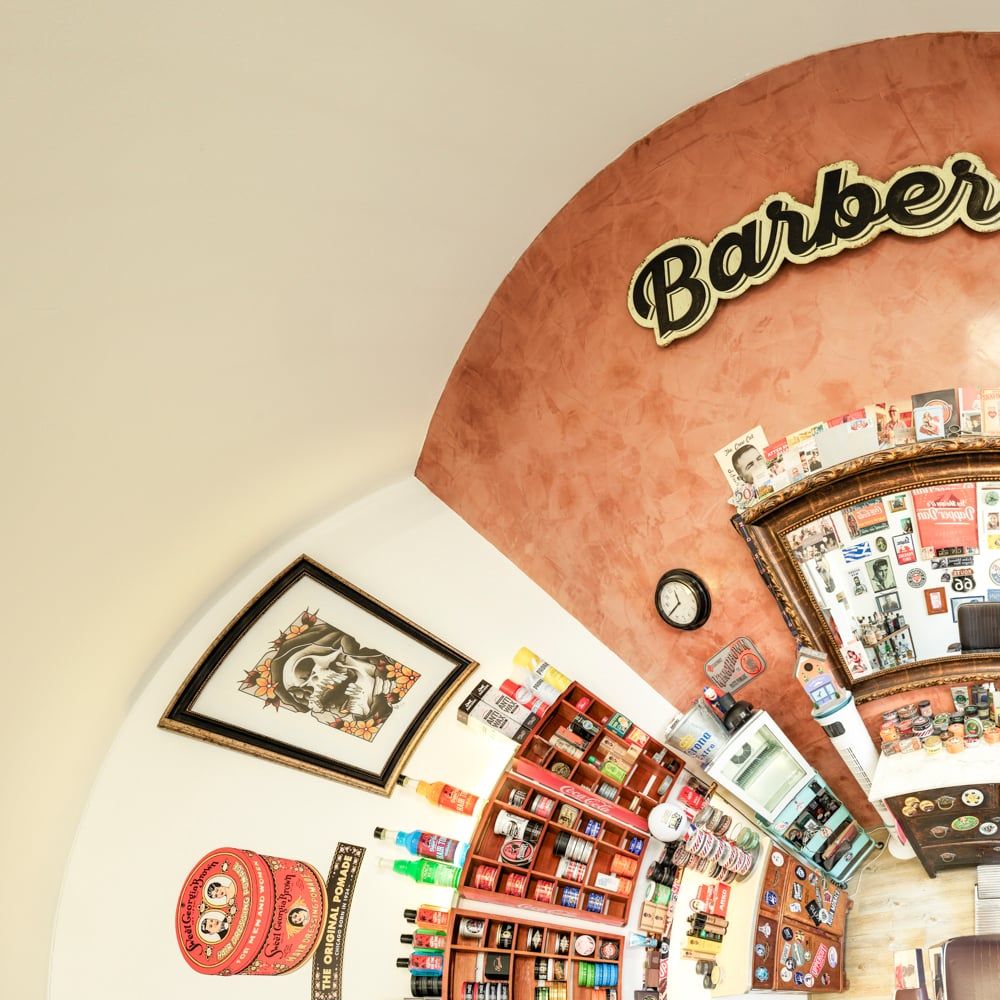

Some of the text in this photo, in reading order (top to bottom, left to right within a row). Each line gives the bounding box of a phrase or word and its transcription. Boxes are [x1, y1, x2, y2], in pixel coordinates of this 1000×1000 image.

[486, 709, 499, 724] ANTI
[498, 695, 511, 709] ANTI
[503, 699, 516, 713] WAX
[491, 713, 505, 728] WAX
[302, 872, 318, 901] POMADE
[718, 889, 727, 911] ARKO
[181, 861, 218, 954] Sweet Georgia Brown
[236, 860, 265, 963] FOR MEN AND WOMEN
[264, 874, 295, 958] Sweet Georgia Brown
[322, 854, 352, 989] THE ORIGINAL POMADE
[302, 902, 318, 943] DRESSING
